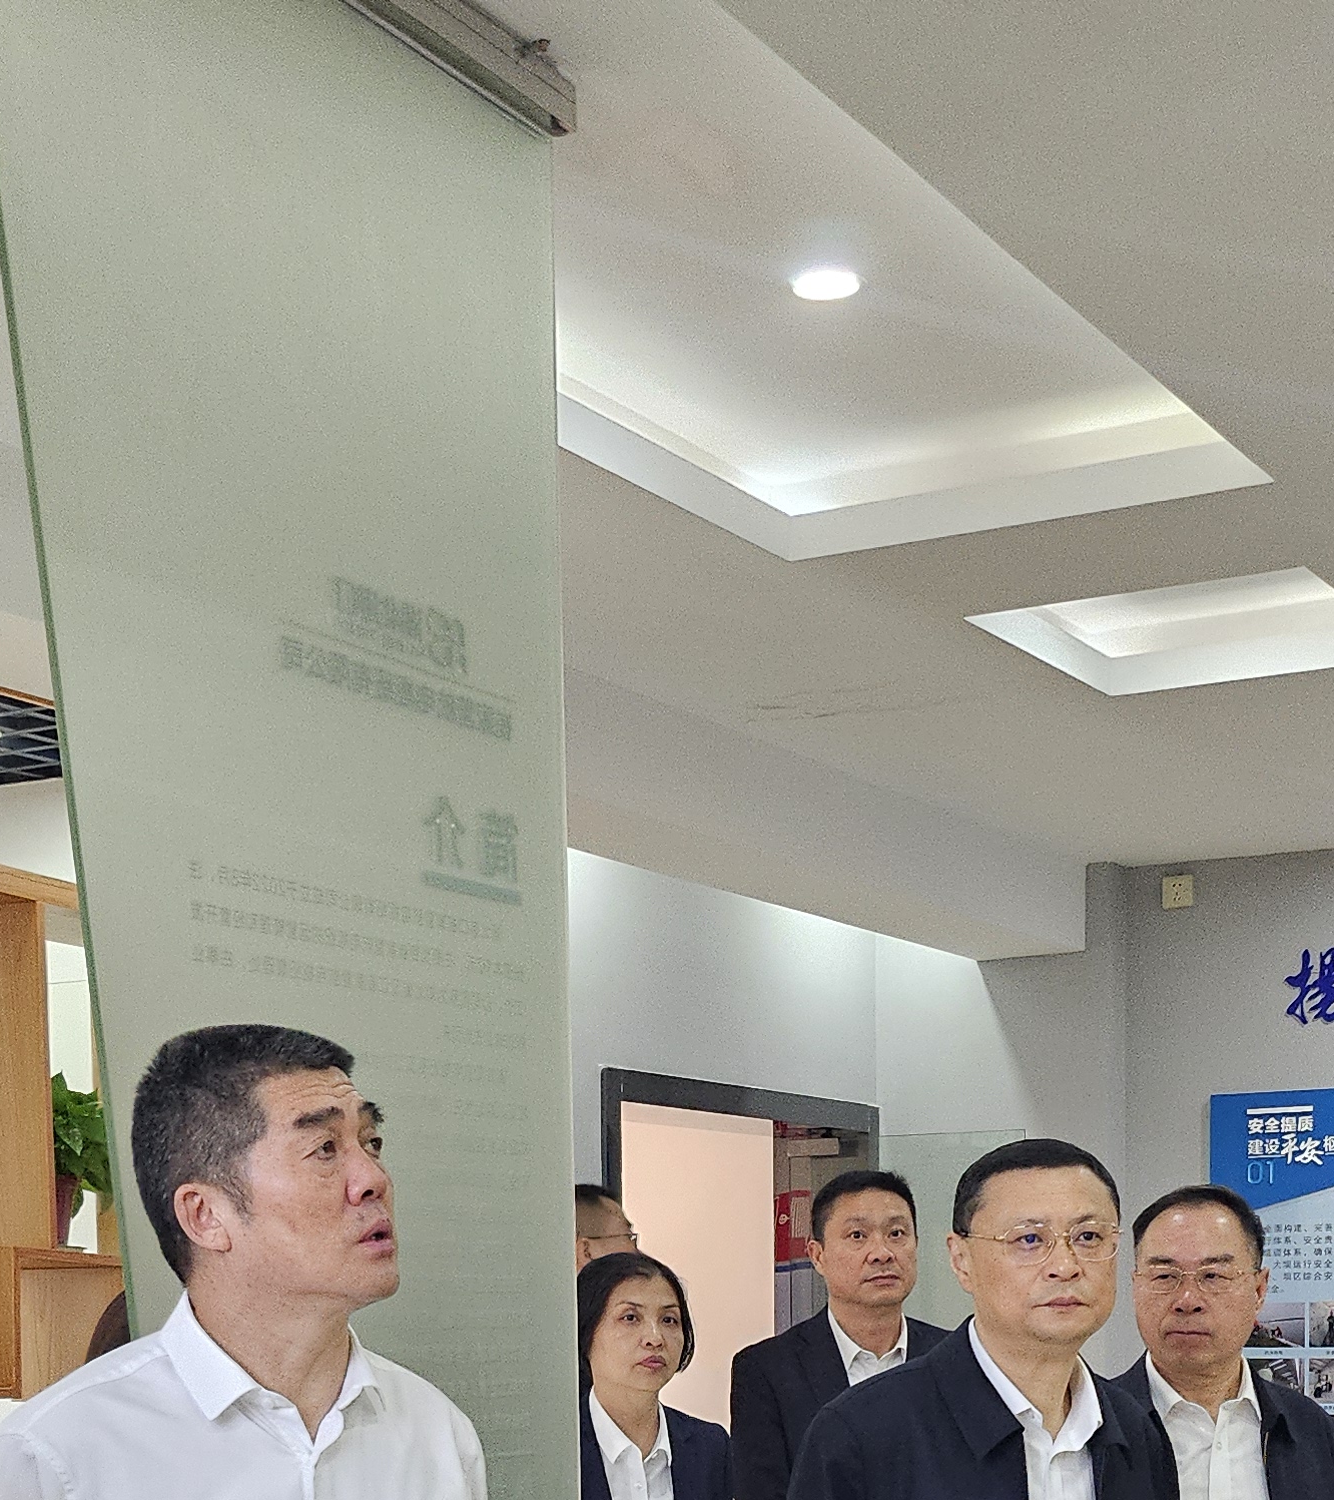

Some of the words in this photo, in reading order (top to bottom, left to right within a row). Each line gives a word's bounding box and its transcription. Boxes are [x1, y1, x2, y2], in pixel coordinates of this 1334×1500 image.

[1248, 1116, 1314, 1134] 安全提质
[1247, 1161, 1274, 1184] 01
